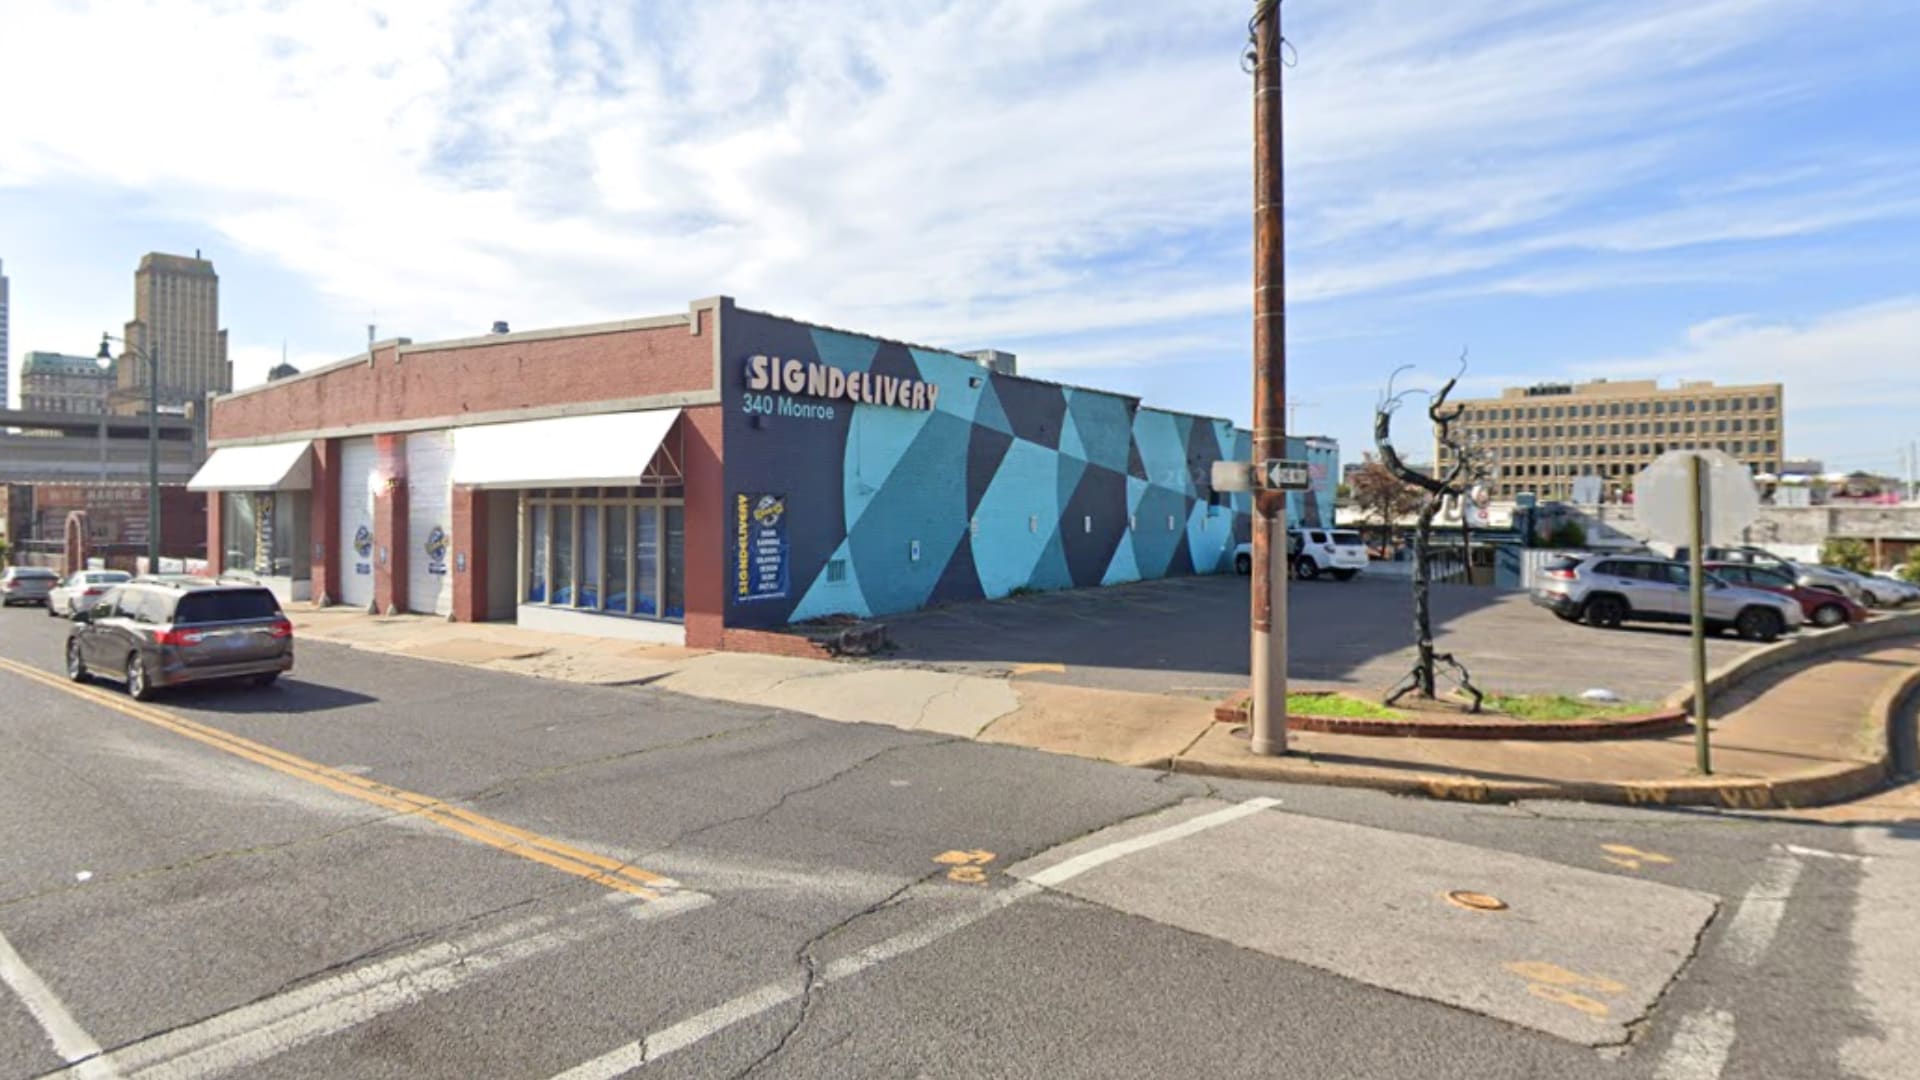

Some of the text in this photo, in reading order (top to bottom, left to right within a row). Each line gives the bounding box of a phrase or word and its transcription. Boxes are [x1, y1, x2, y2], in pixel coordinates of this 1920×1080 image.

[749, 355, 939, 411] SIGNDELIVERY
[743, 393, 834, 419] 340 Monroe
